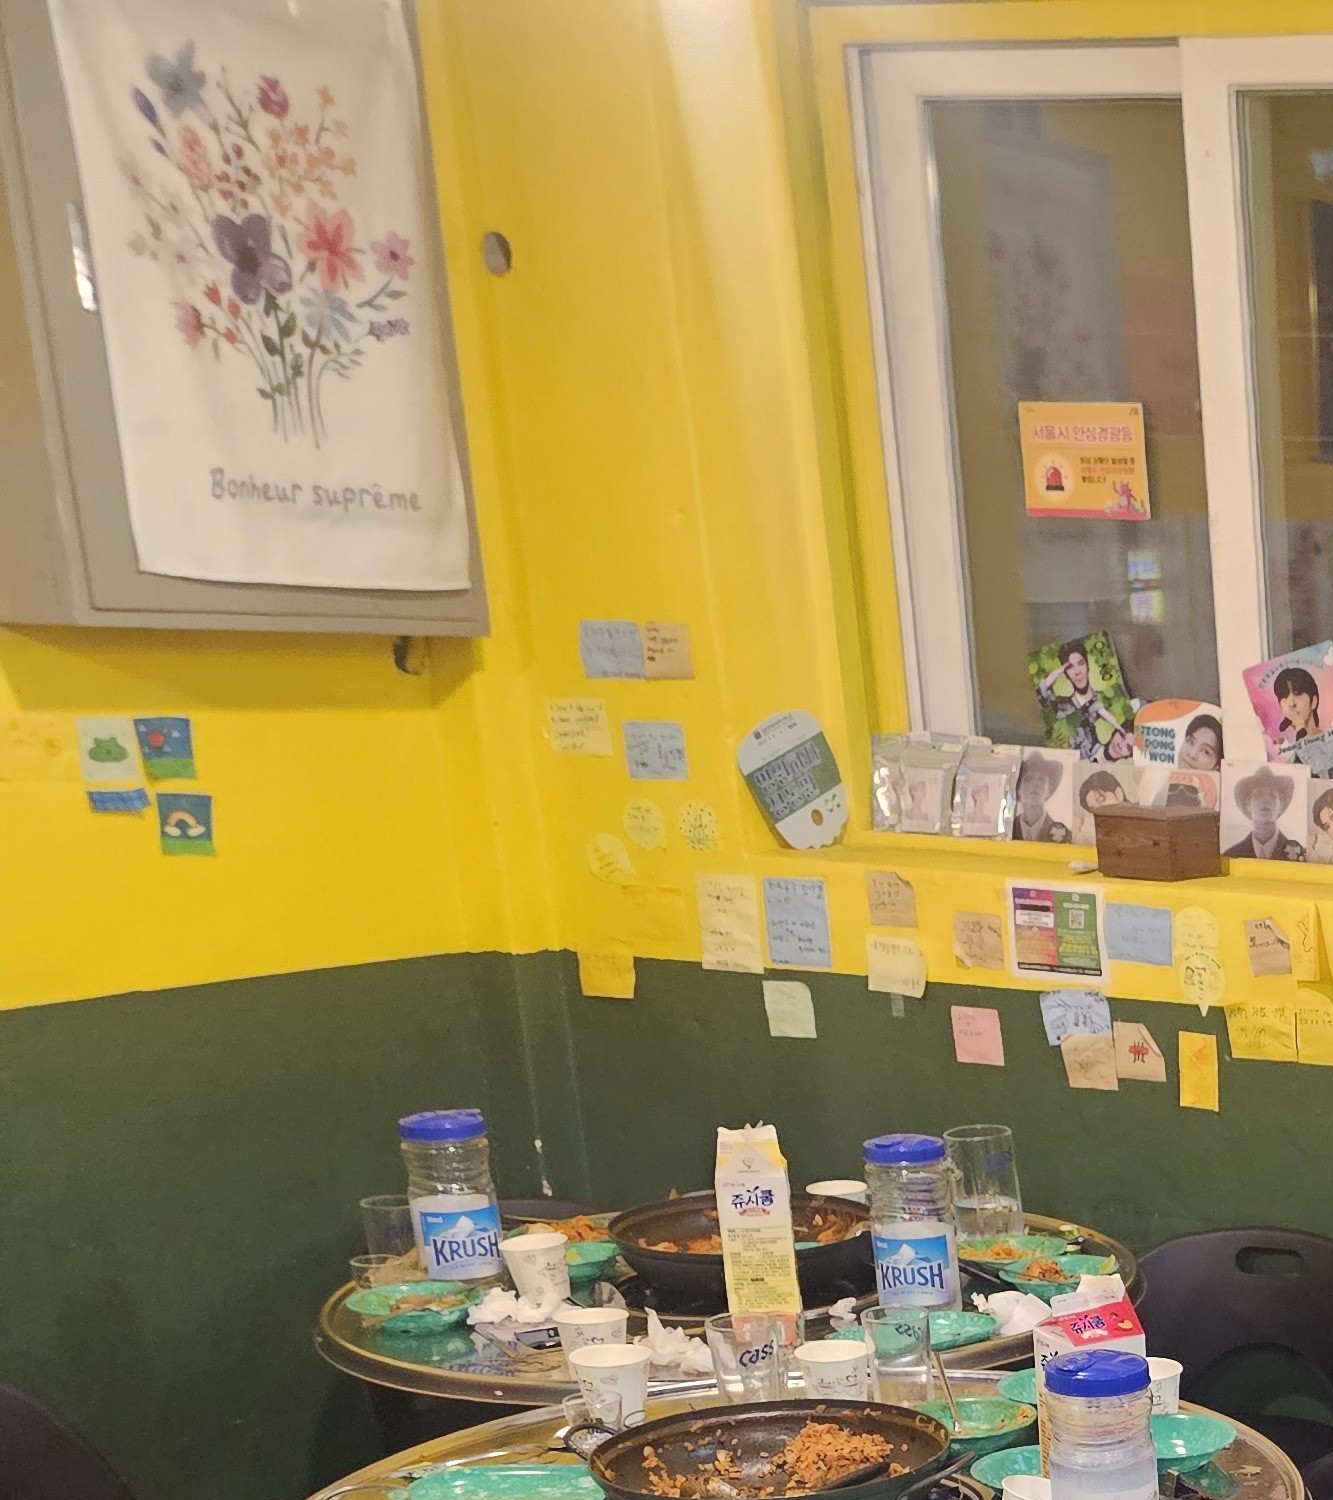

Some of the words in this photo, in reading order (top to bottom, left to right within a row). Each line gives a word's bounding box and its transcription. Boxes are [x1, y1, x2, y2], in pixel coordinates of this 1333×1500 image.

[209, 467, 303, 506] Bonheur
[312, 481, 424, 514] suprême
[1140, 726, 1176, 739] JEONG
[1145, 738, 1176, 751] DONG
[1149, 752, 1175, 765] WON
[730, 1186, 775, 1210] 쥬시쿨
[432, 1231, 501, 1267] KRUSH
[880, 1262, 945, 1291] KRUSH
[1069, 1313, 1107, 1336] 쥬시쿨
